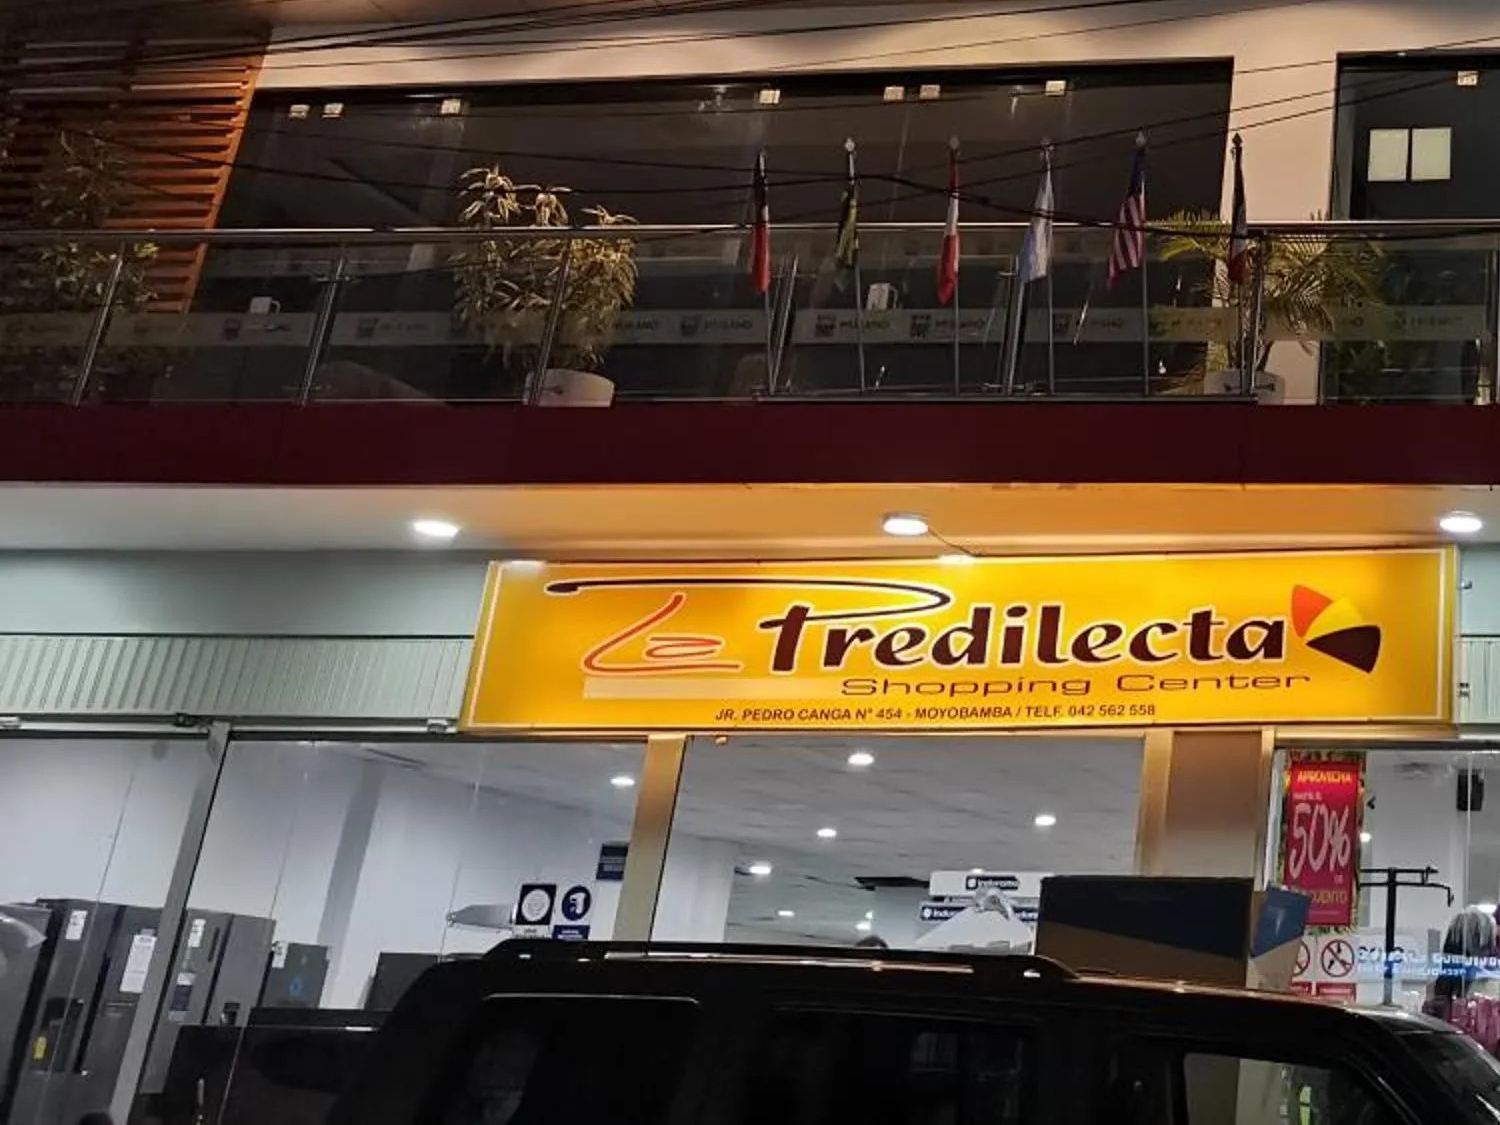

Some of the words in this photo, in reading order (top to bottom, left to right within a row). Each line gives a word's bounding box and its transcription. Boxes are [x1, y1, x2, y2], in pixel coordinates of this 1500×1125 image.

[546, 578, 1284, 672] Predilecta
[841, 677, 1091, 697] Shopping
[1117, 674, 1311, 693] Center
[715, 708, 736, 721] JR.
[741, 708, 795, 721] PEDRO
[797, 708, 851, 721] CANGA
[875, 708, 901, 720] 454
[915, 706, 1011, 720] MOYOBAMBA
[1068, 705, 1095, 718] 042
[1099, 705, 1127, 717] 562
[1129, 705, 1156, 717] 558
[1289, 802, 1351, 879] 50%
